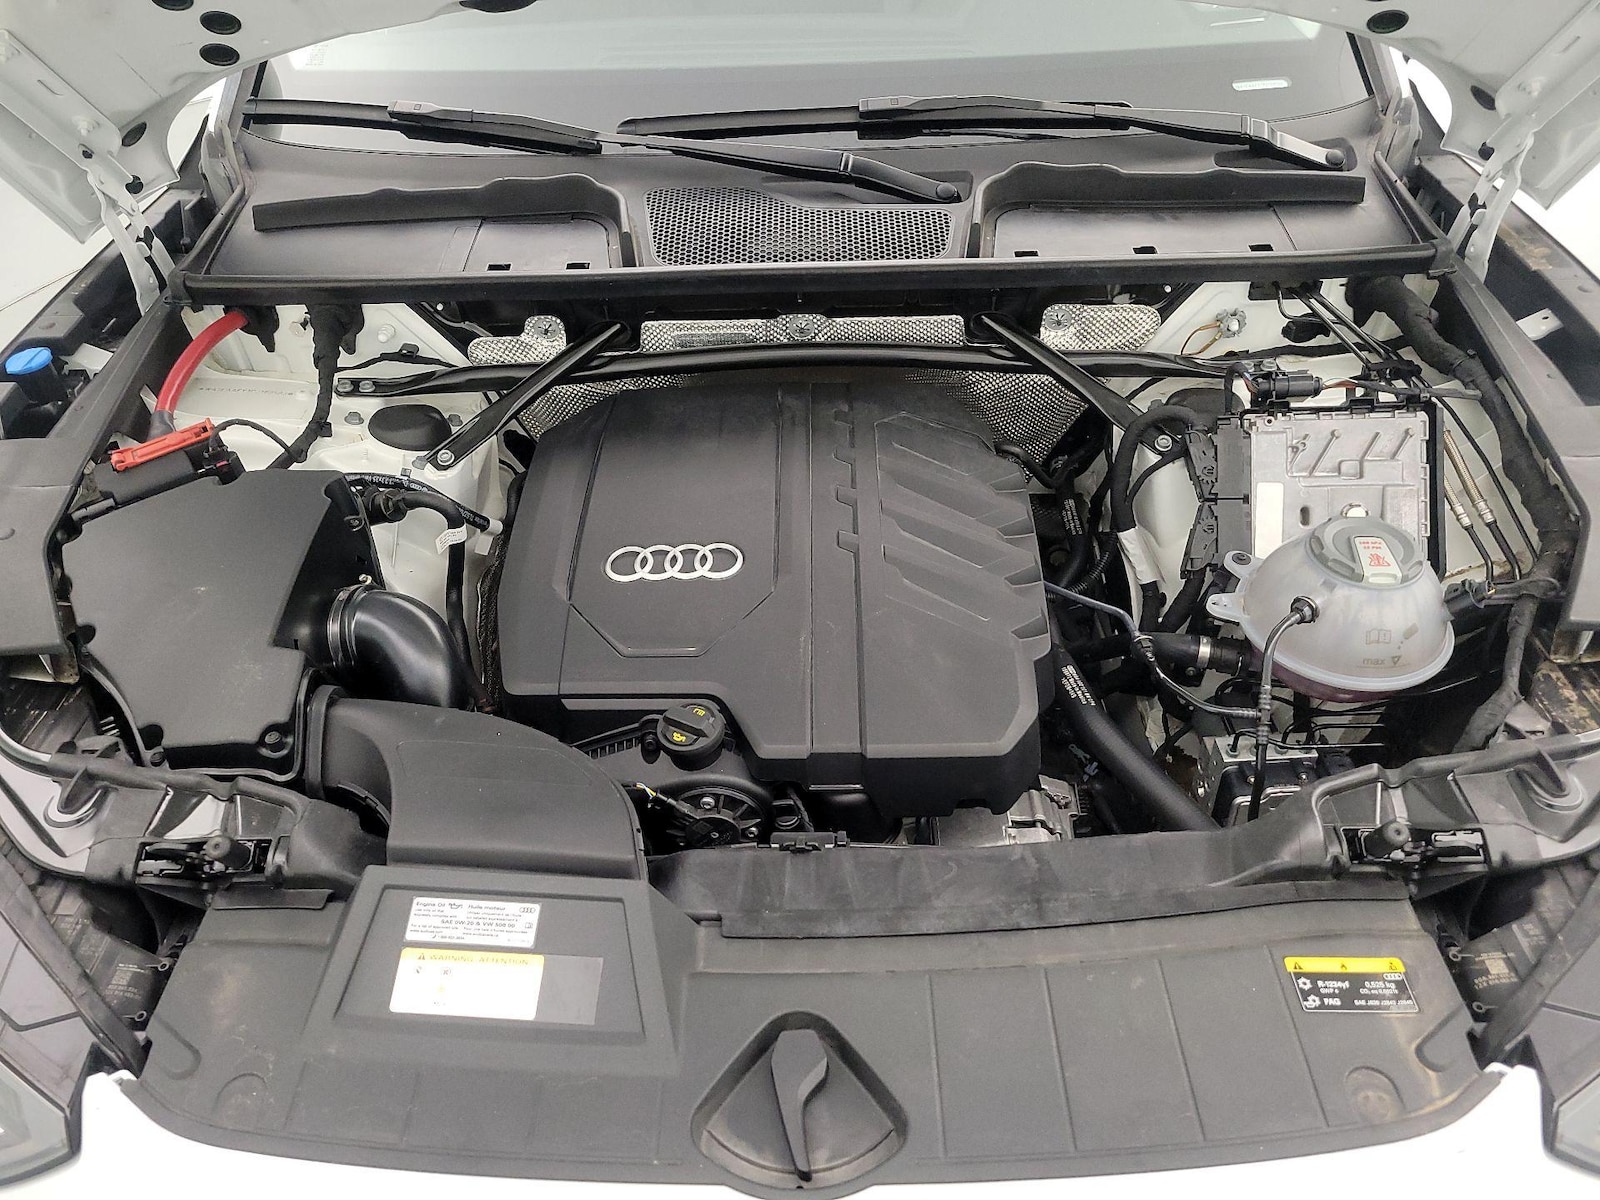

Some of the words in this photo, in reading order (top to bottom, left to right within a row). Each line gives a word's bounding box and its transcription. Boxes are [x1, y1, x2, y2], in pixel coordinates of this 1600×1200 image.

[1362, 657, 1386, 666] max
[1317, 980, 1350, 990] R-1234yf
[1323, 998, 1342, 1006] PAG
